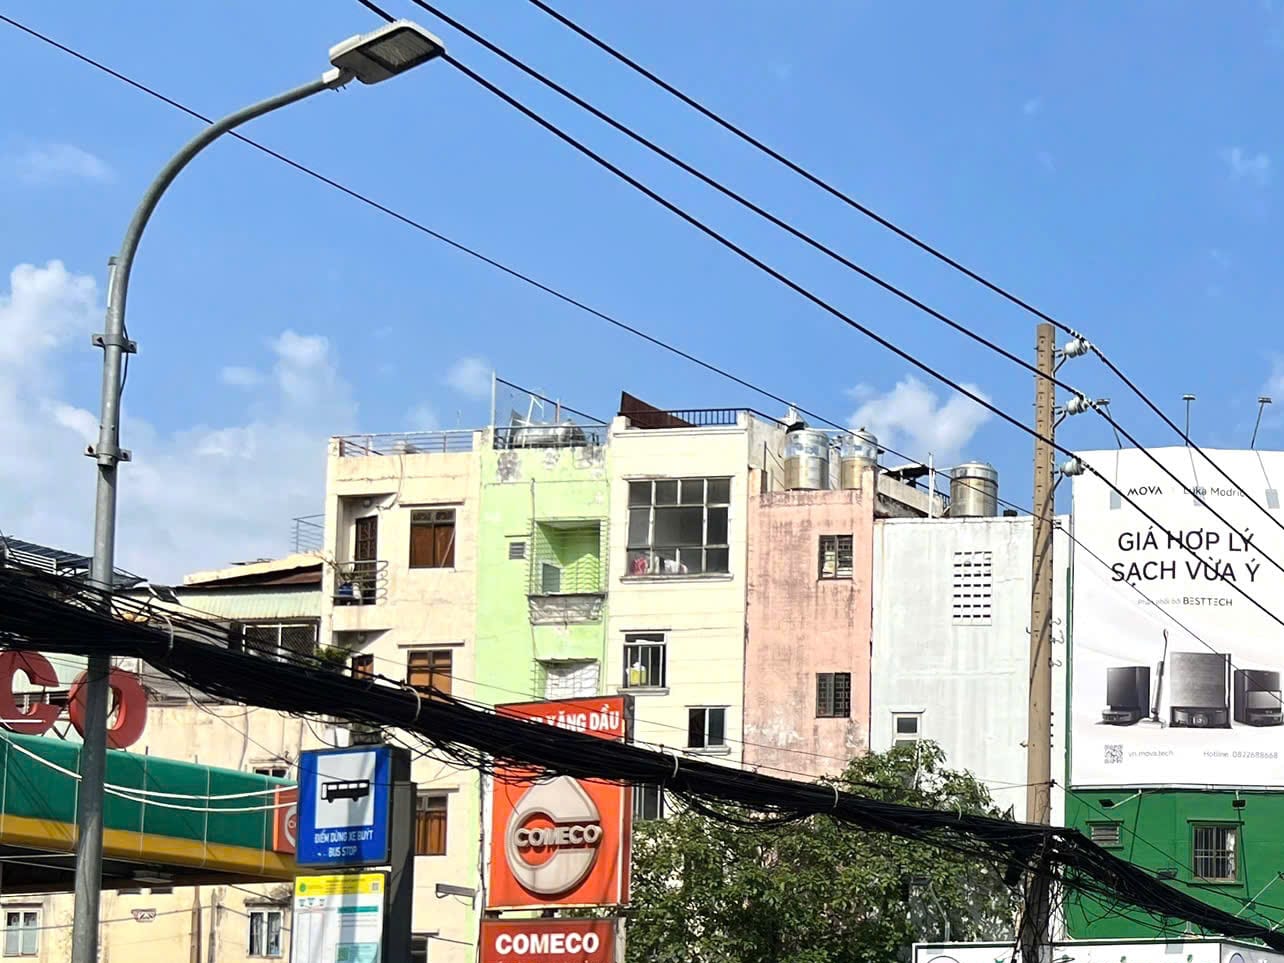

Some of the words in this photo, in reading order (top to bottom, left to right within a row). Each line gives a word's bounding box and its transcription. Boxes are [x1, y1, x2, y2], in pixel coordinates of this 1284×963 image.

[1127, 486, 1163, 497] MOVA
[1118, 526, 1159, 551] GIÁ
[1167, 528, 1220, 556] HỢP
[1229, 528, 1255, 552] LÝ
[1111, 560, 1176, 587] SẠCH
[1185, 557, 1236, 582] VỪA
[1245, 558, 1261, 582] Ý
[590, 704, 619, 730] DẦU
[514, 825, 603, 848] COMECO
[328, 847, 341, 857] BUS
[342, 846, 357, 857] STOP
[495, 932, 600, 955] COMECO
